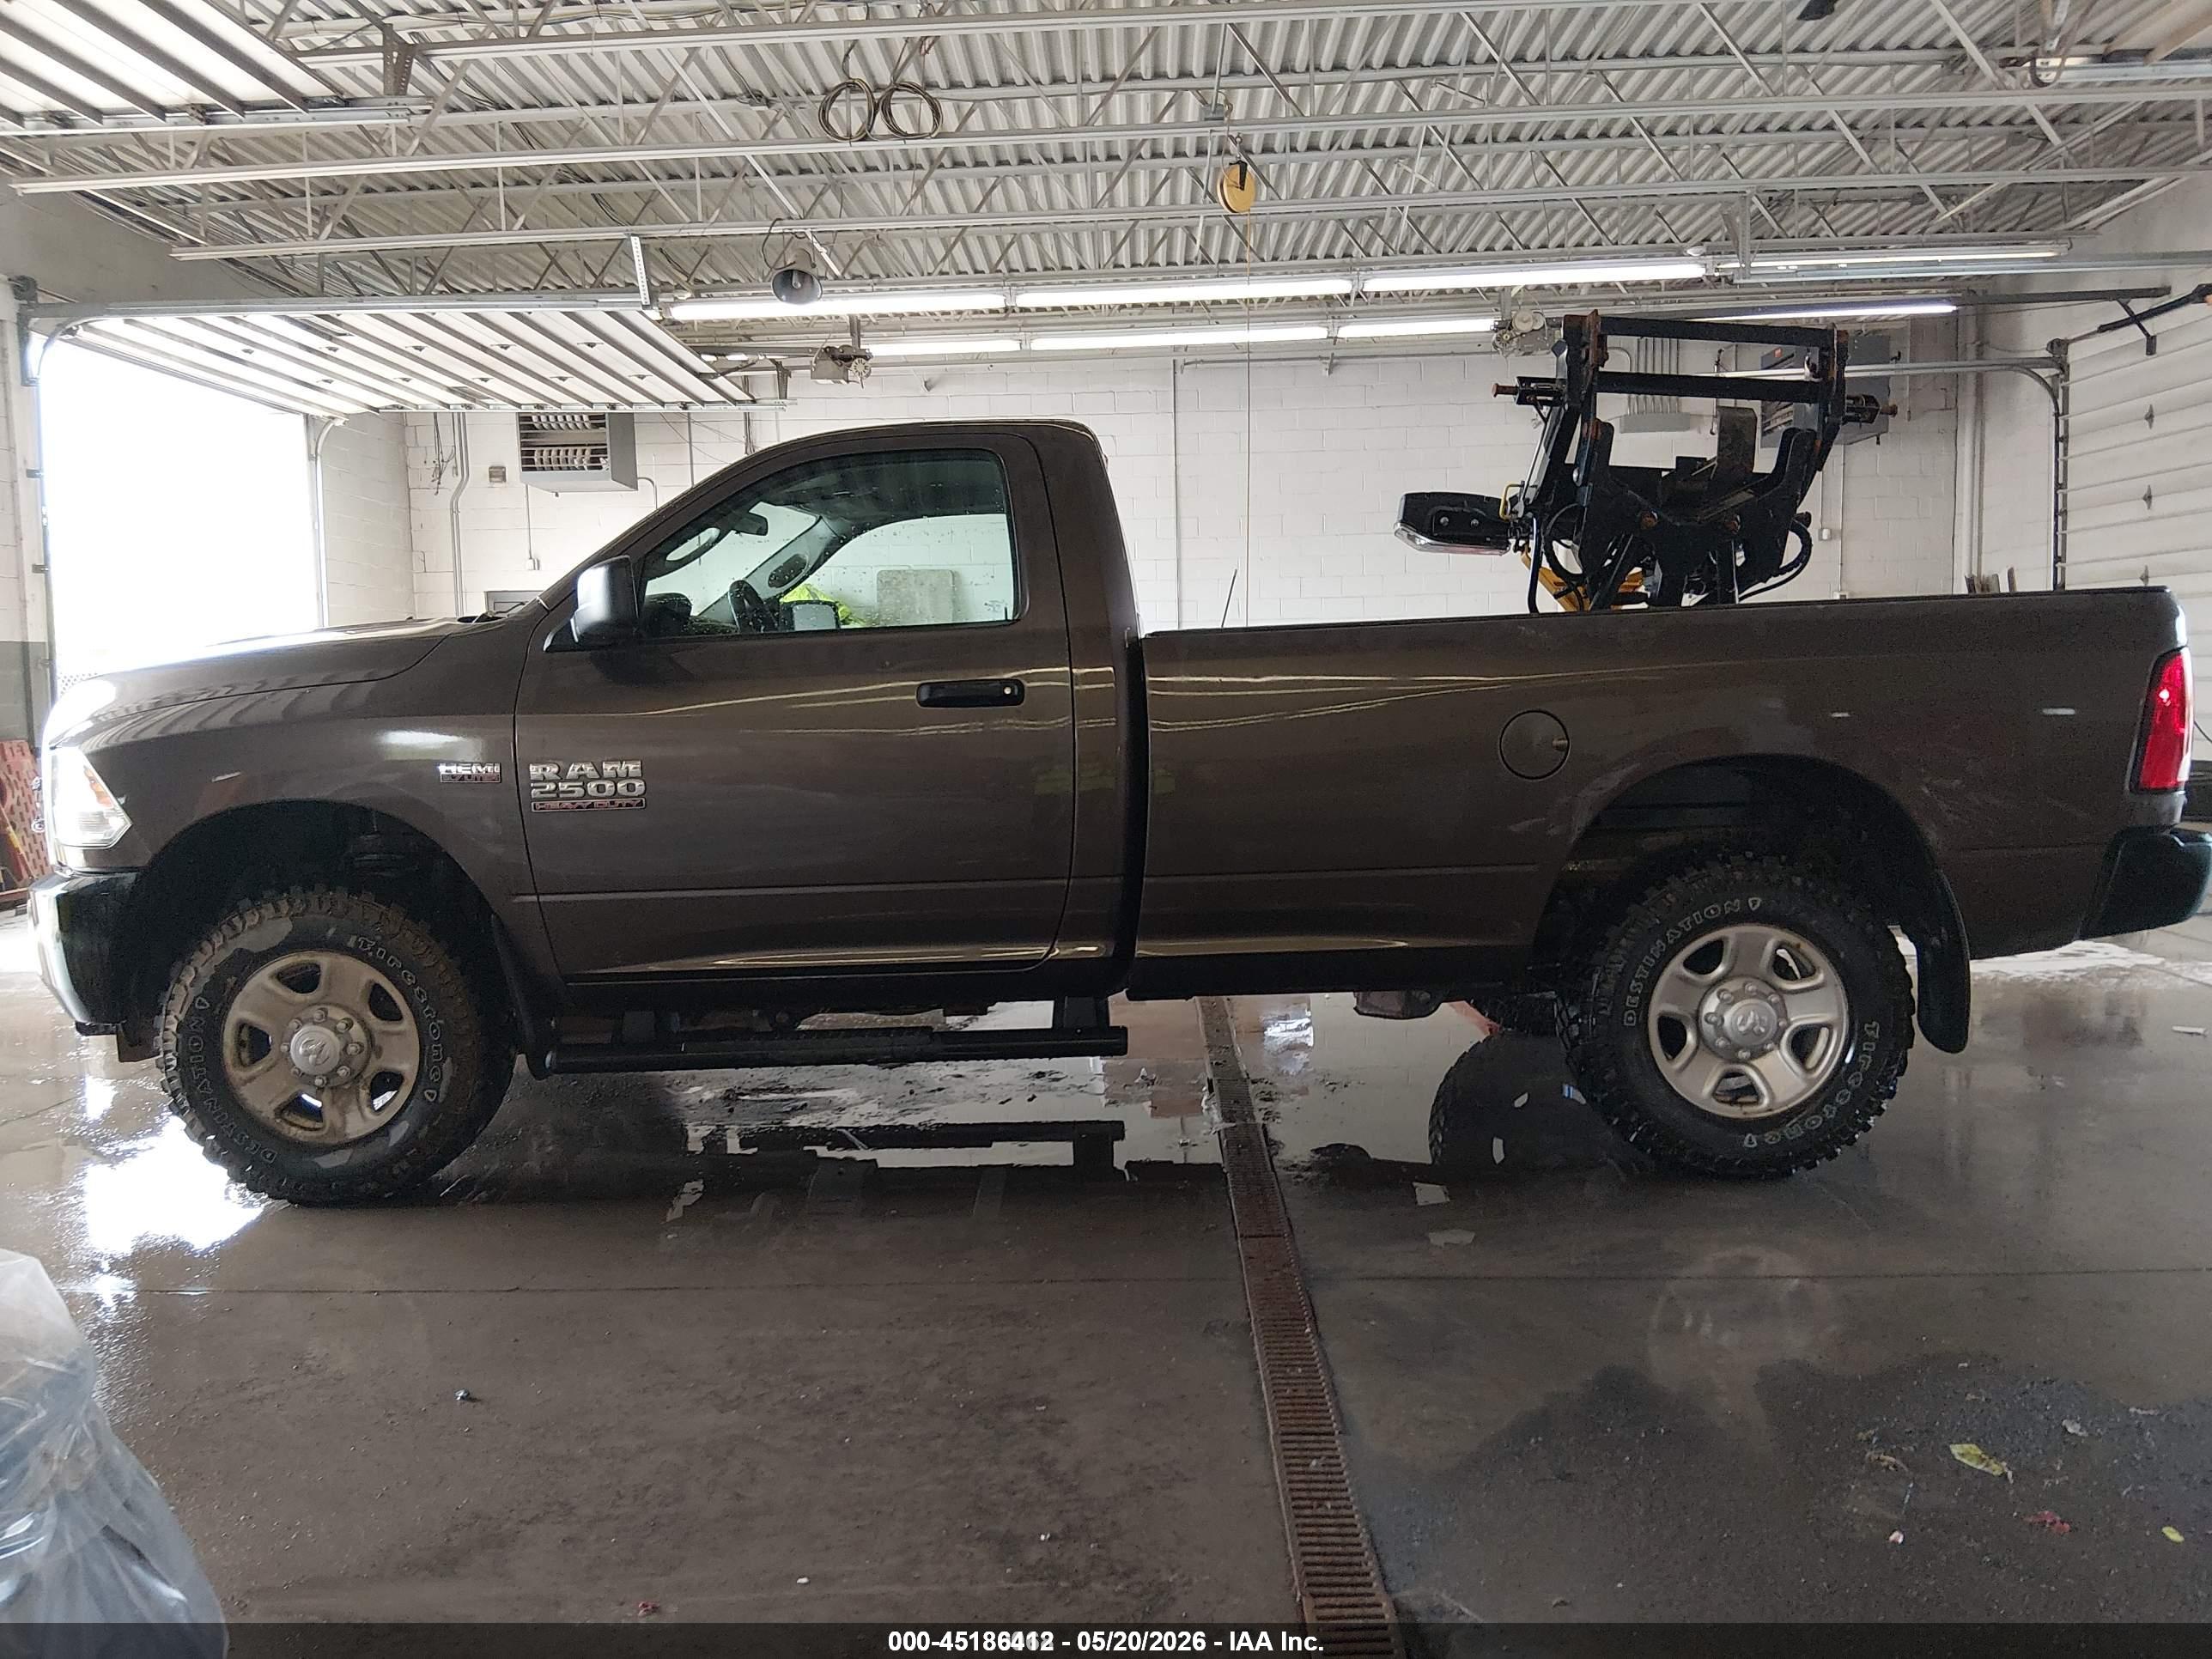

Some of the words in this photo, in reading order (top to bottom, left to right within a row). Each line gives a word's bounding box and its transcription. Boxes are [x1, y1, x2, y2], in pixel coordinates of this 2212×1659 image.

[438, 763, 501, 774] HEMI
[529, 761, 642, 781] RAM
[530, 779, 646, 799] 2500
[1623, 899, 1741, 1026] DESTINATION
[187, 1016, 277, 1164] DESTINATION
